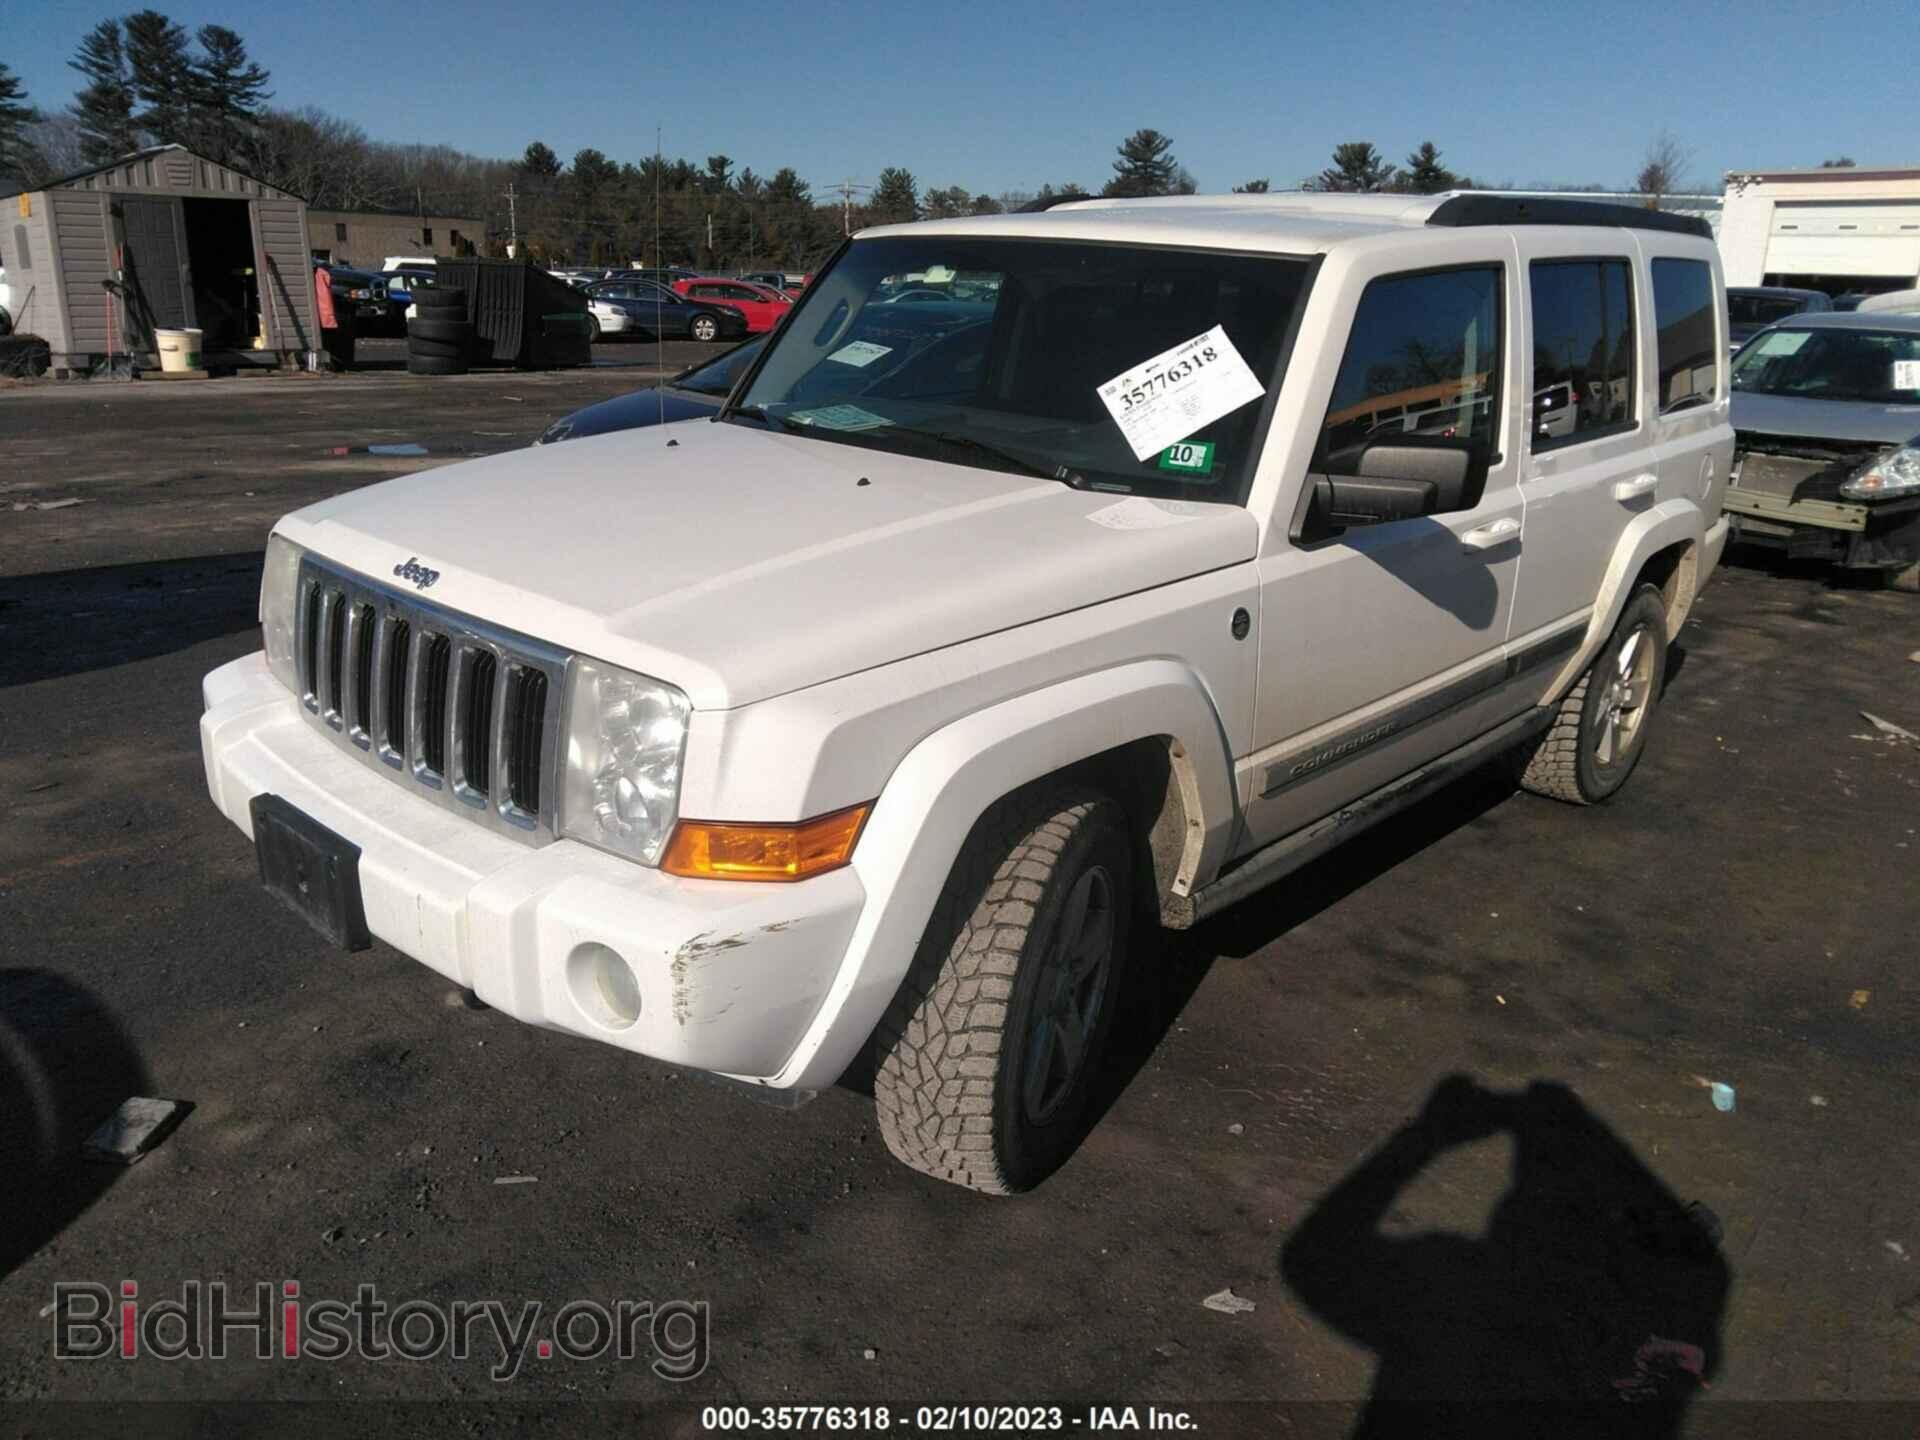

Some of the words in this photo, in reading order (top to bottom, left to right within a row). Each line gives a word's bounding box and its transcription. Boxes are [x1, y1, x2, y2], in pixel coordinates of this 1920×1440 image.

[1119, 346, 1217, 410] 35776318
[1169, 444, 1193, 463] 10
[393, 556, 440, 590] Jeep
